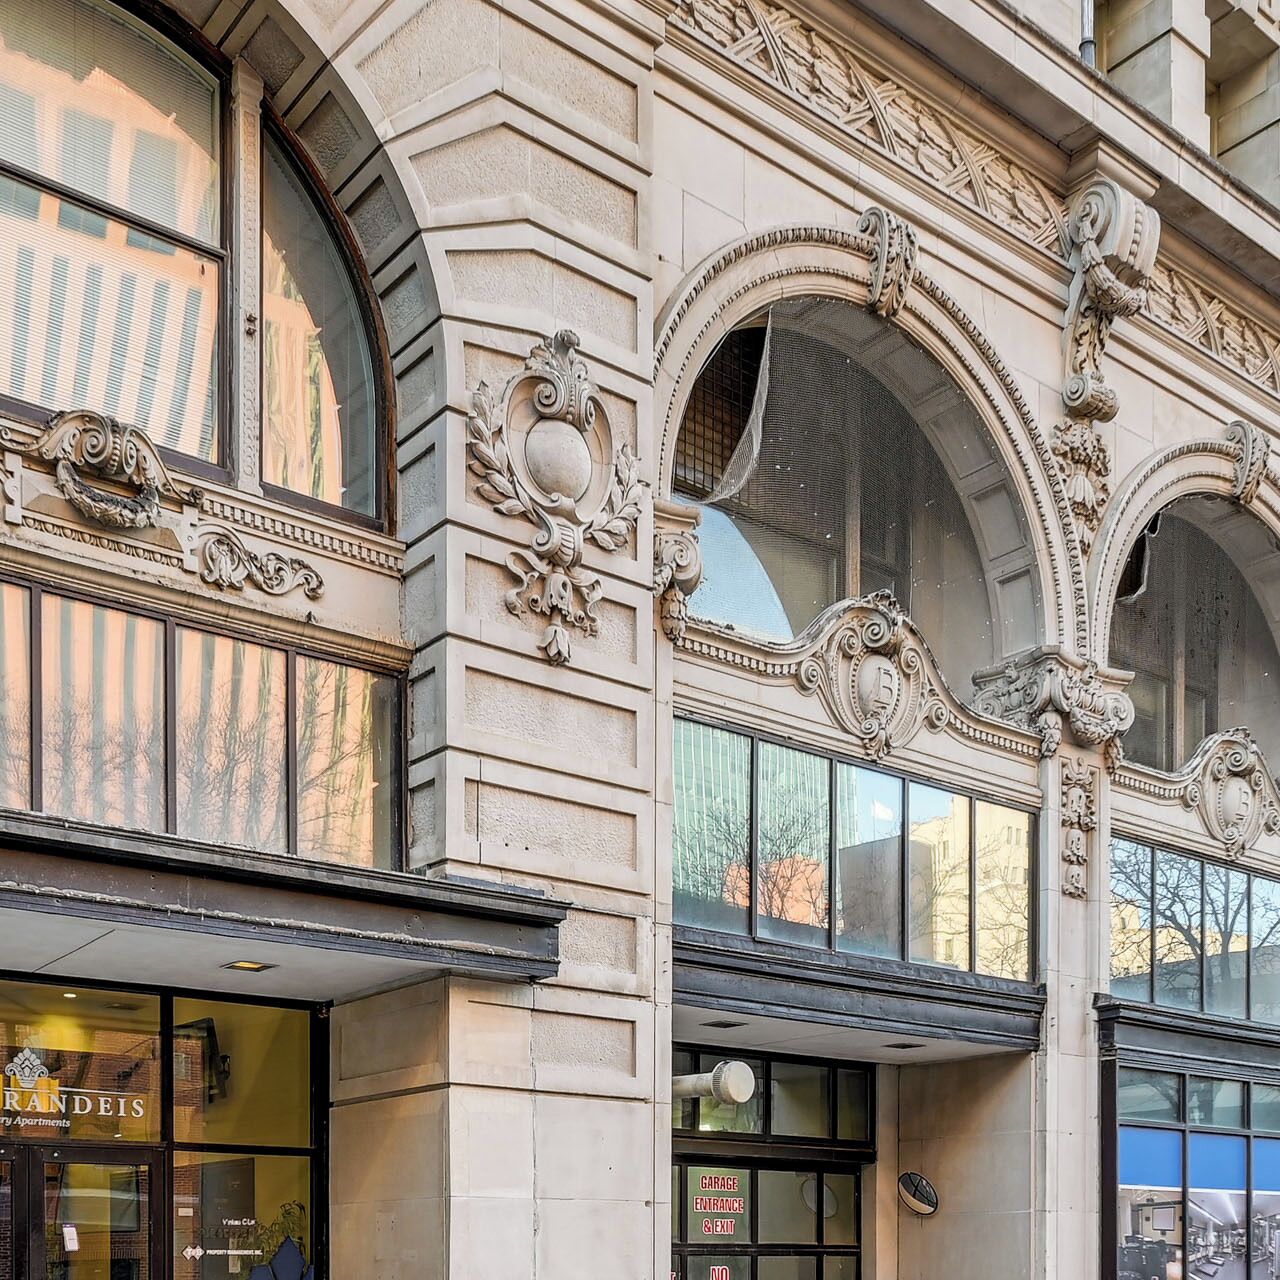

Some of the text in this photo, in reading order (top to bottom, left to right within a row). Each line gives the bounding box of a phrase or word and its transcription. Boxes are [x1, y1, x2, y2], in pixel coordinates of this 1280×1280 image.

[13, 1115, 71, 1129] Apartments
[700, 1175, 738, 1191] GARAGE
[693, 1196, 744, 1213] ENTRANCE
[703, 1219, 735, 1234] & EXIT
